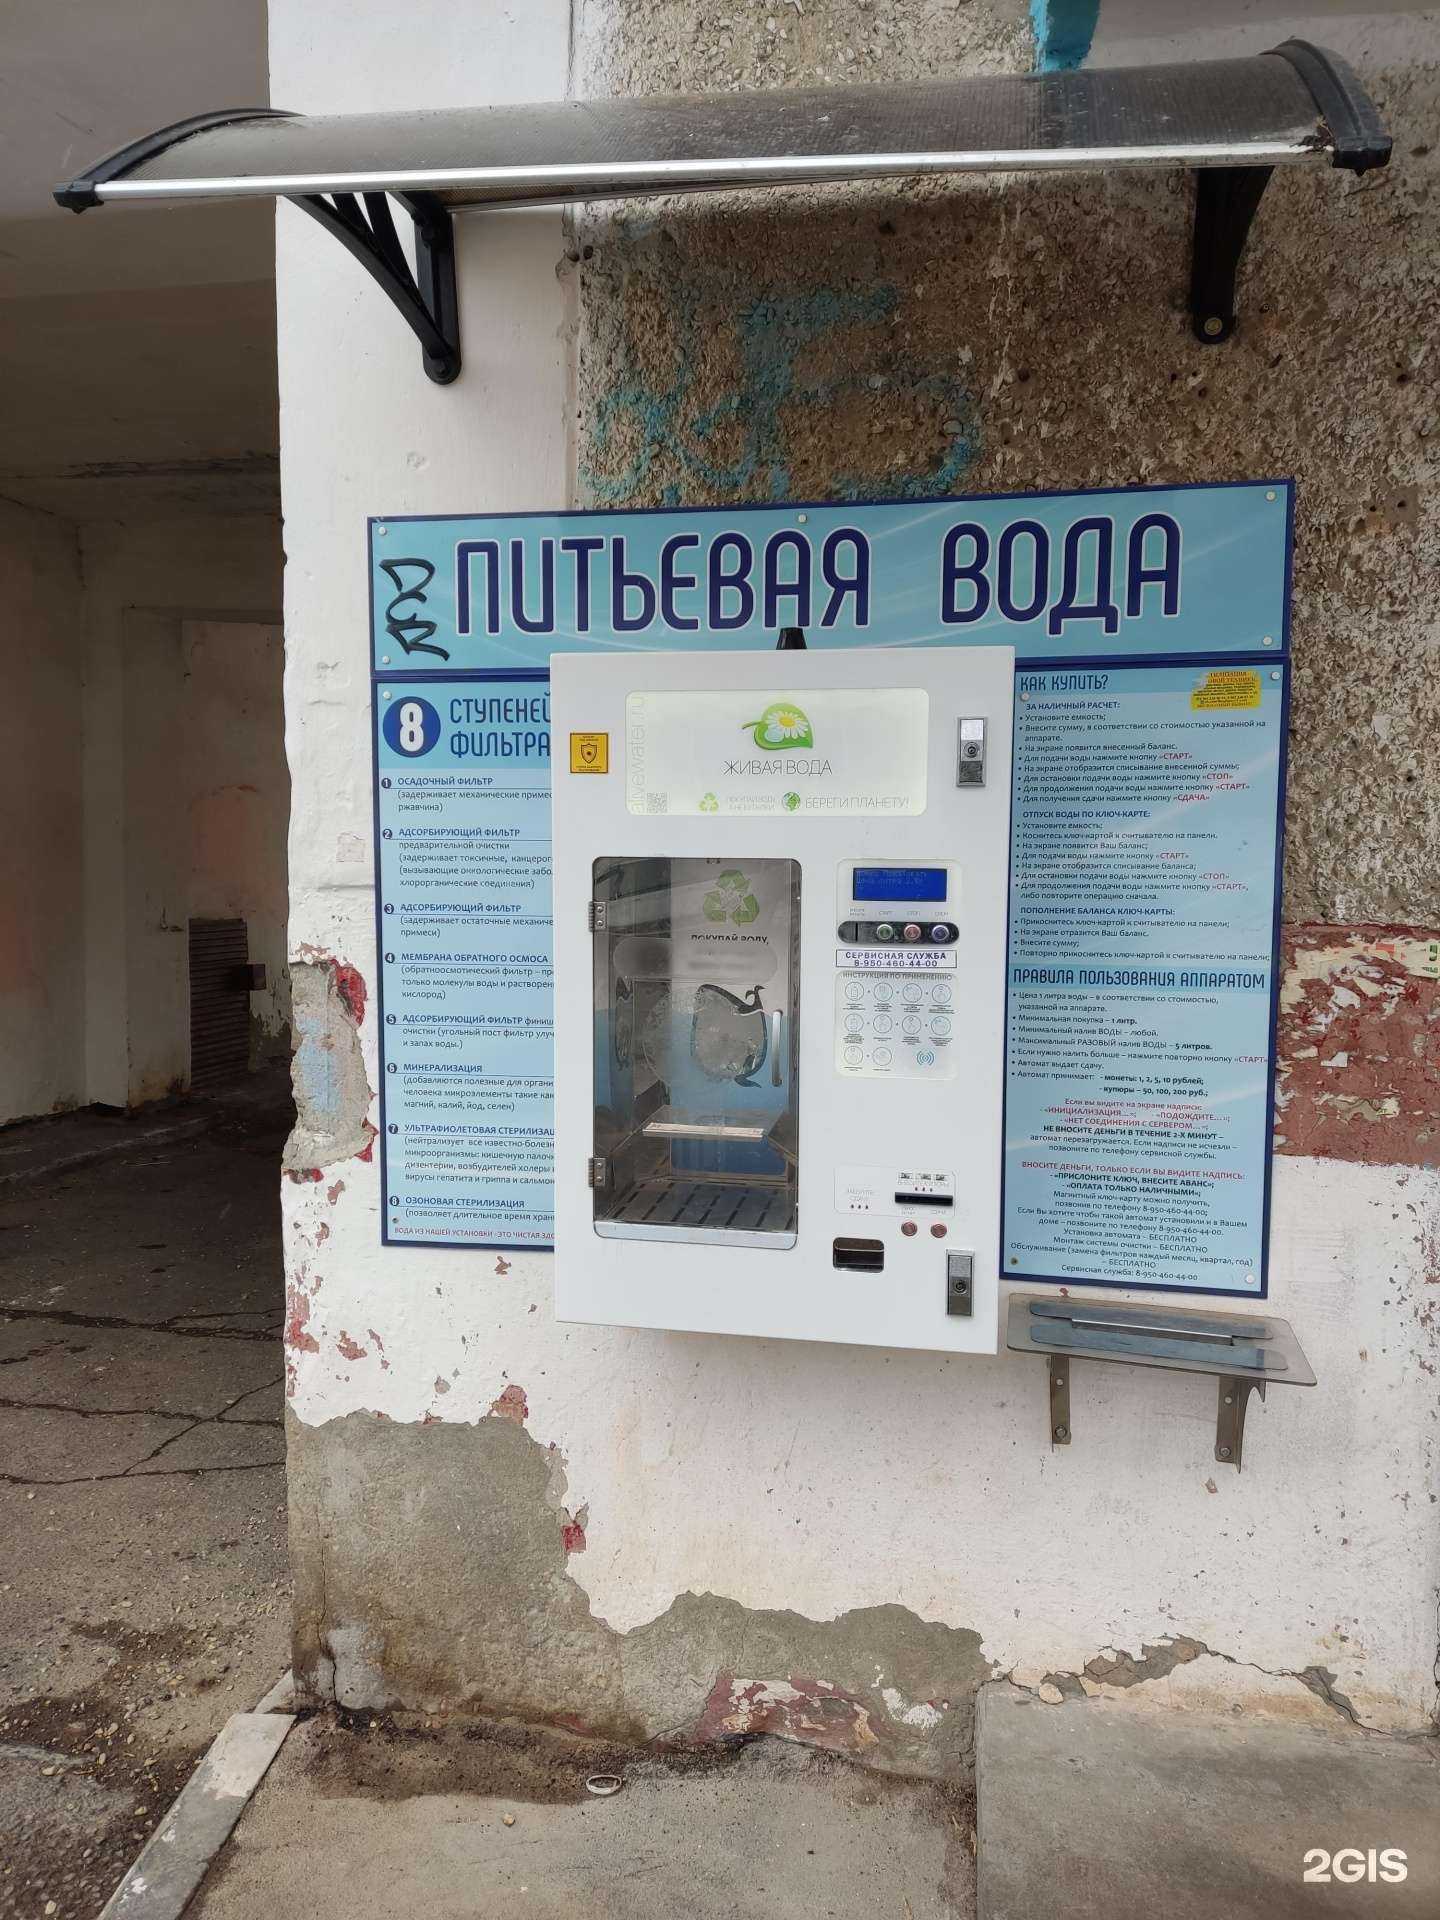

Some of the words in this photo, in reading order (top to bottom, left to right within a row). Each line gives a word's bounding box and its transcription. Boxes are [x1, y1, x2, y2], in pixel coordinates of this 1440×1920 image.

[456, 527, 871, 636] ПИТЬЕВАЯ
[940, 513, 1182, 636] ВОДА
[1020, 675, 1046, 691] КАК
[1052, 674, 1109, 690] КУПИТЬ?
[1039, 701, 1085, 710] НАЛИЧНЫЙ
[1025, 713, 1069, 722] Установите
[400, 703, 423, 751] 8
[1040, 755, 1068, 763] подачи
[1160, 752, 1193, 760] «СТАРТ»
[721, 760, 782, 775] ЖИВАЯ
[786, 759, 832, 775] ВОДА
[398, 776, 455, 786] ОСАДОЧНЫЙ
[458, 777, 493, 786] ФИЛЬТР
[398, 790, 456, 801] (задерживает
[459, 791, 519, 799] механические
[398, 802, 443, 812] ржавчина)
[806, 796, 848, 809] БЕРЕГИ
[852, 796, 909, 809] ПЛАНЕТУ!
[1023, 810, 1053, 818] ОТПУСК
[1056, 810, 1080, 819] ВОДЫ
[1082, 810, 1093, 818] ПО
[399, 828, 482, 838] АДСОРБИРУЮЩИЙ
[485, 829, 520, 837] ФИЛЬТР
[400, 903, 483, 913] АДСОРБИРУЮЩИЙ
[486, 904, 521, 912] ФИЛЬТР
[1020, 907, 1076, 915] ПОПОЛНЕНИЕ
[1078, 907, 1115, 915] БАЛАНСА
[461, 917, 511, 925] остаточные
[400, 929, 440, 938] примеси)
[402, 953, 452, 961] МЕМБРАНА
[502, 968, 532, 976] фильтр
[1014, 969, 1073, 984] ПРАВИЛА
[1080, 970, 1175, 986] ПОЛЬЗОВАНИЯ
[1181, 973, 1265, 988] АППАРАТОМ
[433, 980, 474, 988] молекулы
[402, 991, 446, 999] кислород)
[403, 1015, 485, 1024] АДСОРБИРУЮЩИЙ
[438, 1029, 480, 1037] (угольный
[504, 1030, 533, 1038] фильтр
[403, 1077, 462, 1085] (добавляются
[1104, 1087, 1134, 1095] купюры
[488, 1103, 515, 1111] селен)
[404, 1124, 496, 1133] УЛЬТРАФИОЛЕТОВАЯ
[1055, 1125, 1092, 1134] ВНОСИТЕ
[1095, 1128, 1126, 1137] ДЕНЬГИ
[1135, 1130, 1171, 1138] ТЕЧЕНИЕ
[1187, 1131, 1217, 1140] МИНУТ
[405, 1137, 464, 1145] (нейтрализует
[482, 1152, 524, 1160] кишечную
[405, 1162, 455, 1170] дизентерии,
[458, 1163, 516, 1172] возбудителей
[1022, 1161, 1058, 1170] ВНОСИТЕ
[1060, 1163, 1094, 1173] ДЕНЬГИ,
[1096, 1165, 1128, 1173] ТОЛЬКО
[1168, 1169, 1200, 1178] ВИДИТЕ
[1113, 1176, 1139, 1185] КЛЮЧ,
[1141, 1178, 1178, 1186] ВНЕСИТЕ
[1105, 1185, 1137, 1193] ТОЛЬКО
[406, 1197, 453, 1205] ОЗОНОВАЯ
[456, 1199, 525, 1208] СТЕРИЛИЗАЦИЯ
[406, 1209, 450, 1218] (позволяет
[1150, 1234, 1197, 1243] БЕСПЛАТНО
[1159, 1244, 1208, 1253] БЕСПЛАТНО
[1109, 1259, 1156, 1268] БЕСПЛАТНО
[1062, 1265, 1101, 1274] Сервисная
